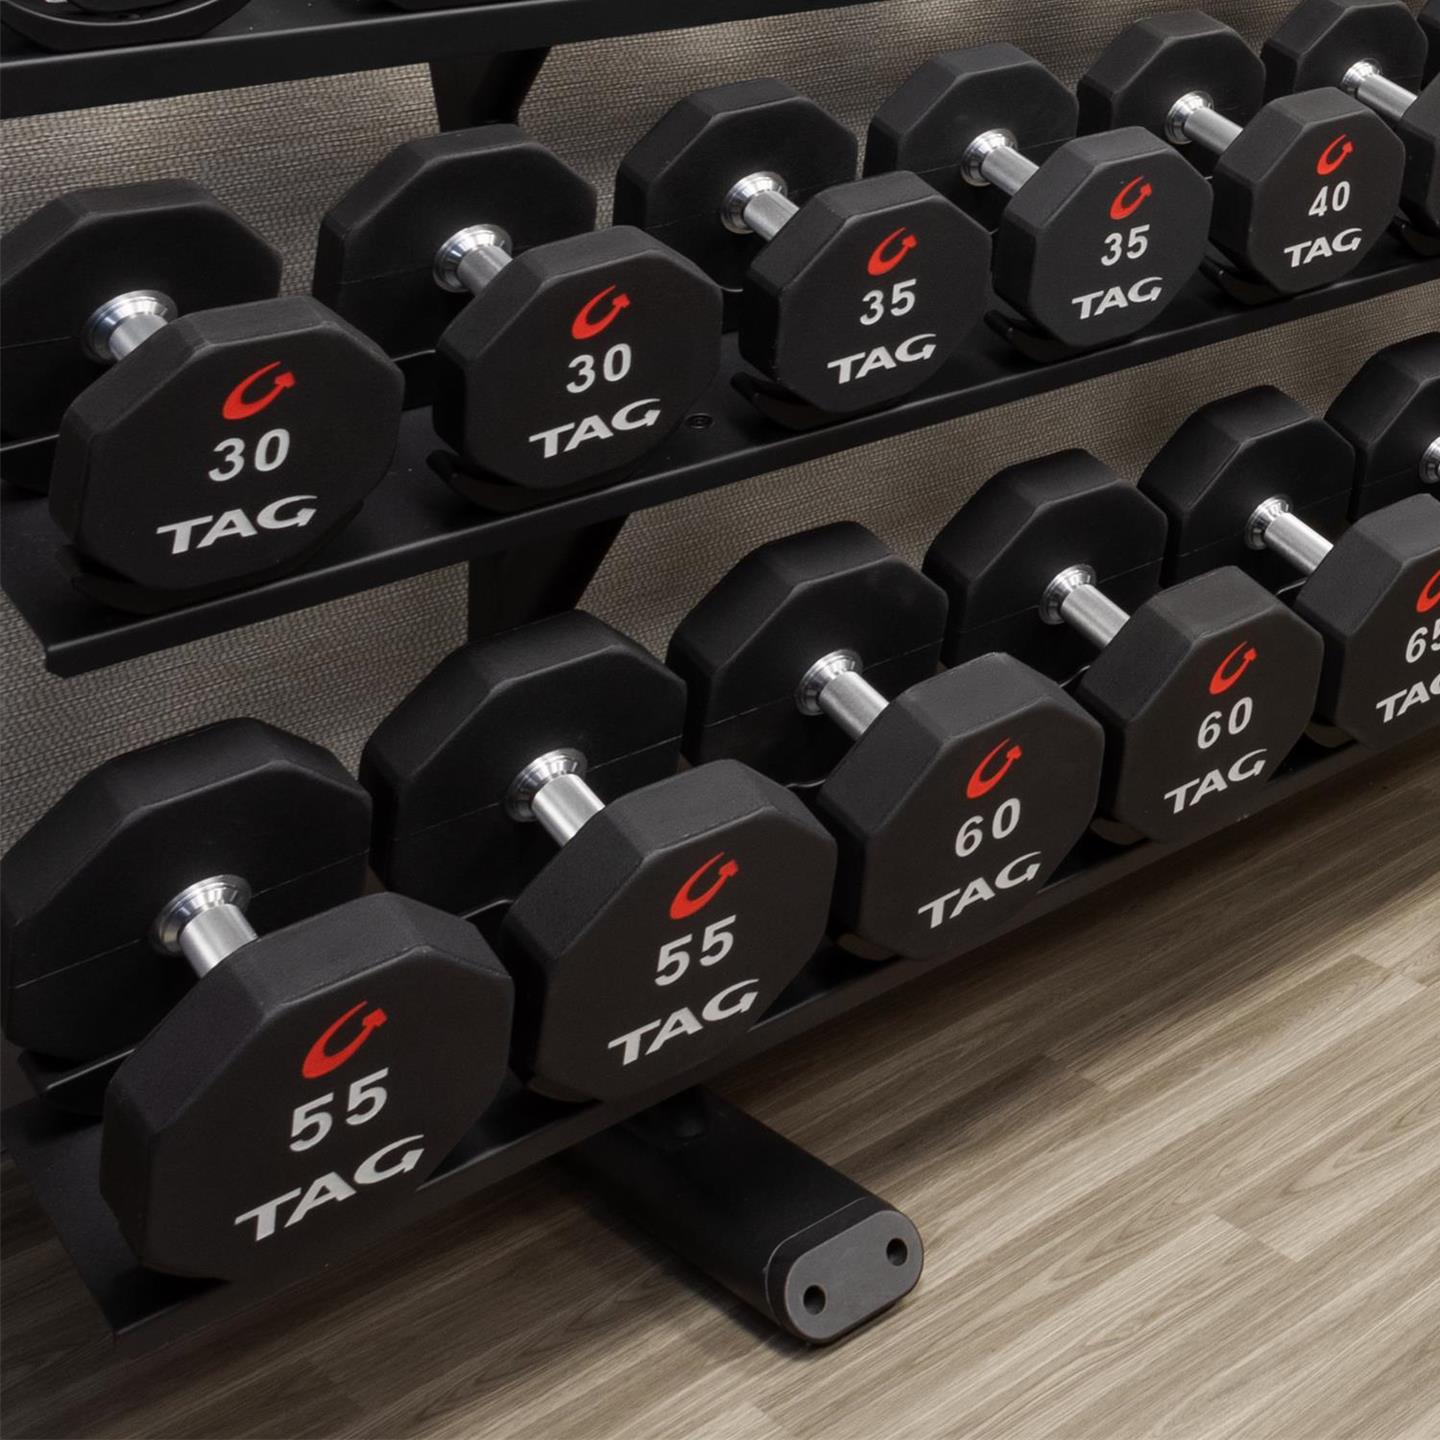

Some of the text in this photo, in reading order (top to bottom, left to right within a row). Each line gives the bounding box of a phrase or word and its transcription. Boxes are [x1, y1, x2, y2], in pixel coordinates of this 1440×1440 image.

[1308, 180, 1351, 217] 40
[1100, 223, 1150, 267] 35
[1283, 227, 1362, 268] TAG
[859, 278, 917, 326] 35
[1071, 276, 1163, 320] TAG
[566, 343, 632, 394] 30
[827, 333, 937, 385] TAG
[208, 428, 290, 482] 30
[529, 398, 661, 458] TAG
[156, 495, 317, 555] TAG
[1197, 696, 1253, 750] 60
[1163, 747, 1267, 815] TAG
[954, 797, 1022, 858] 60
[917, 851, 1042, 930] TAG
[654, 914, 739, 987] 55
[607, 977, 760, 1067] TAG
[289, 1067, 391, 1154] 55
[235, 1133, 424, 1242] TAG
